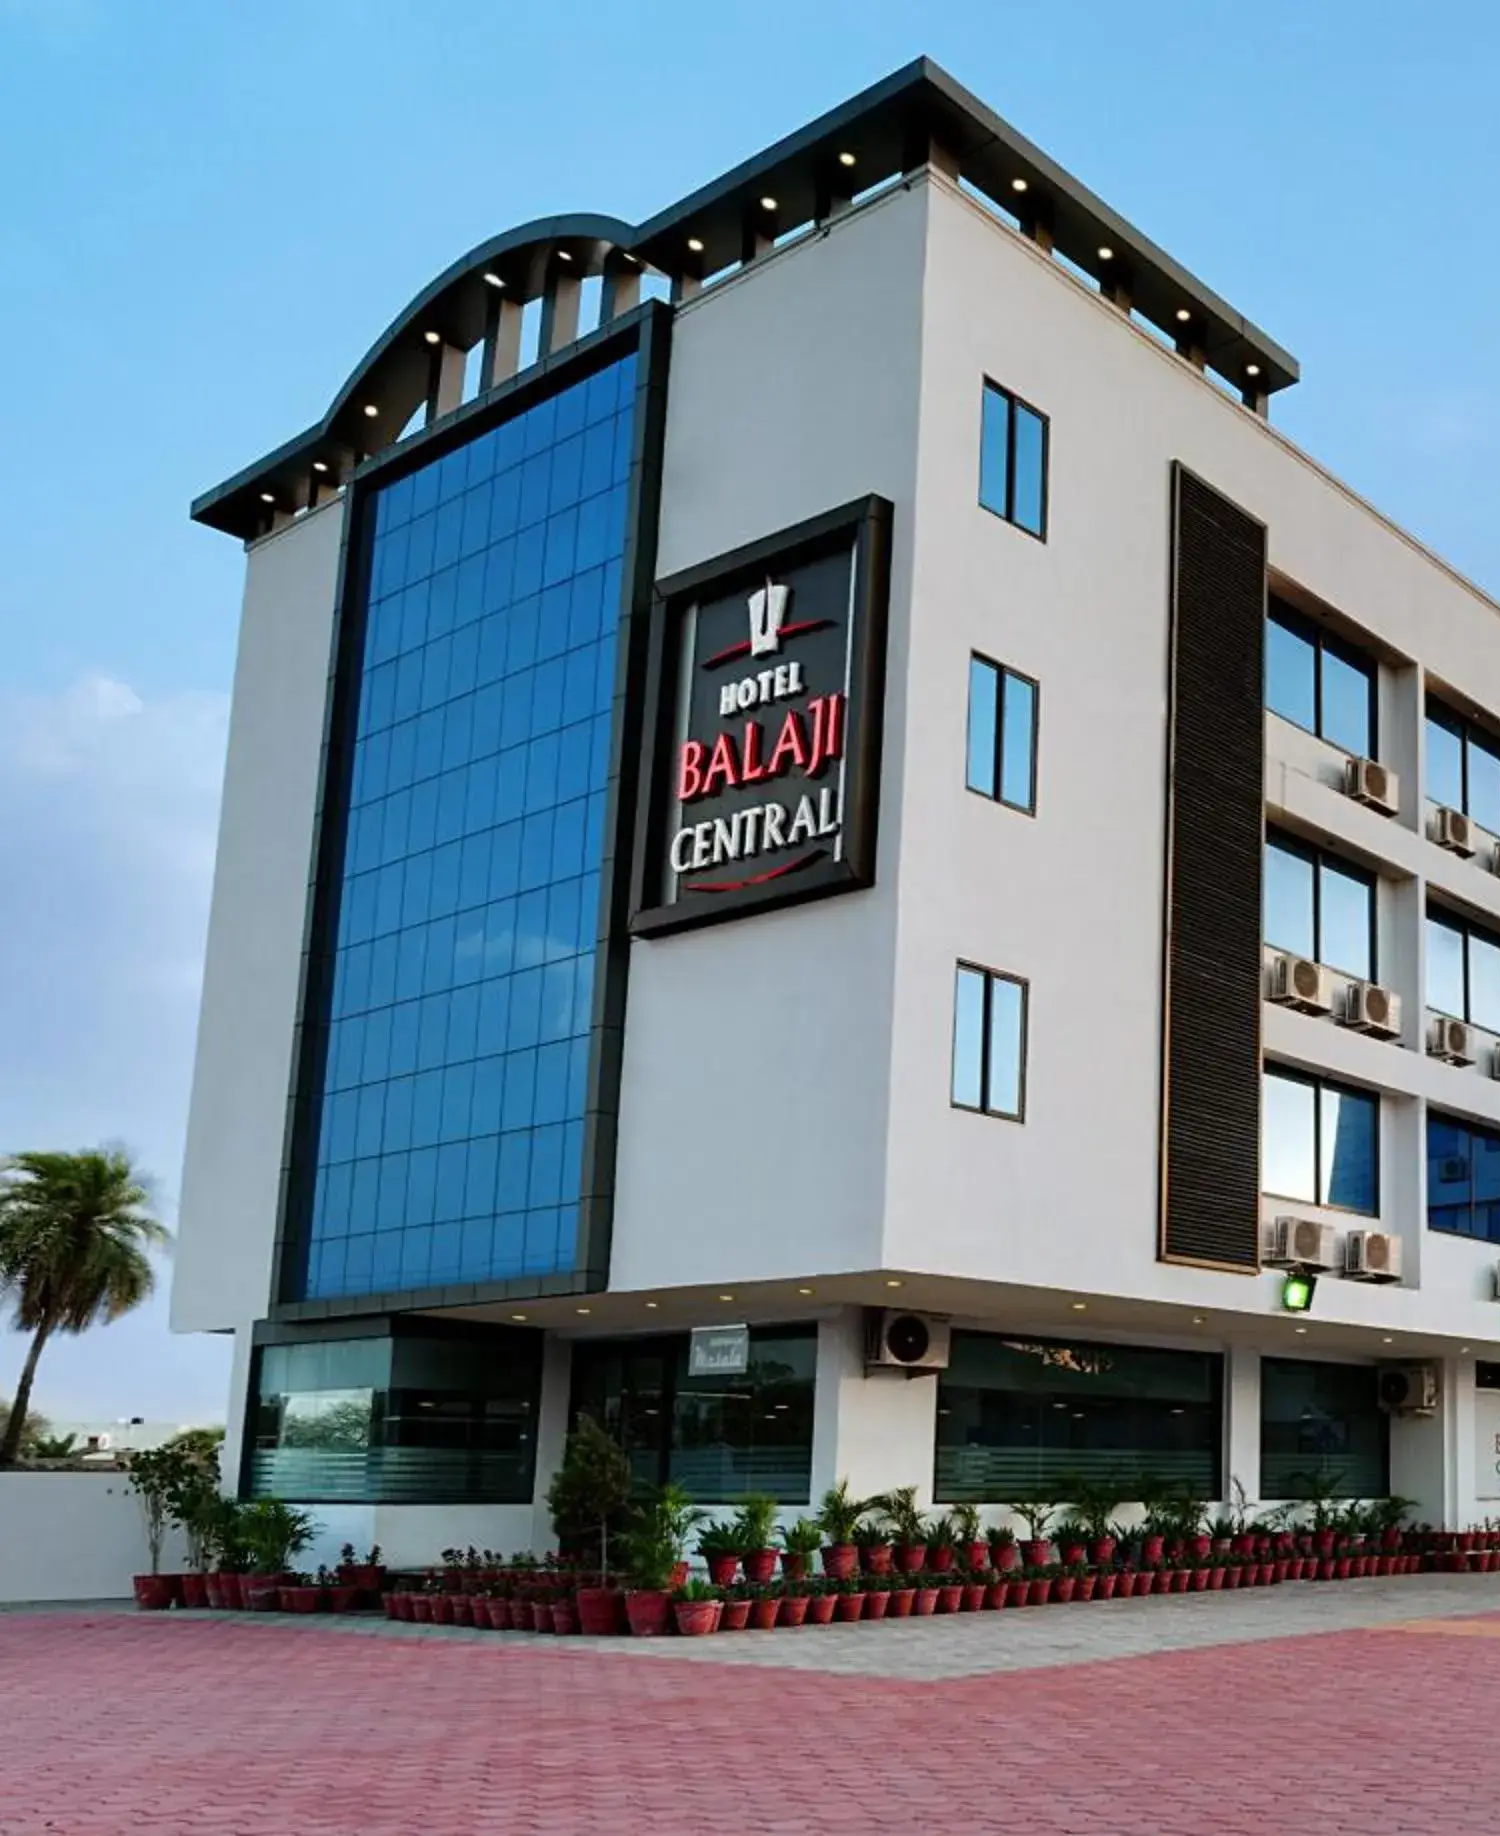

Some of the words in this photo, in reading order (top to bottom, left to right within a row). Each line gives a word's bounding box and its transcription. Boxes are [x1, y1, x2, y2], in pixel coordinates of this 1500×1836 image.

[720, 661, 803, 717] HOTEL
[677, 693, 843, 801] BALAJI
[670, 788, 841, 875] CENTRAL
